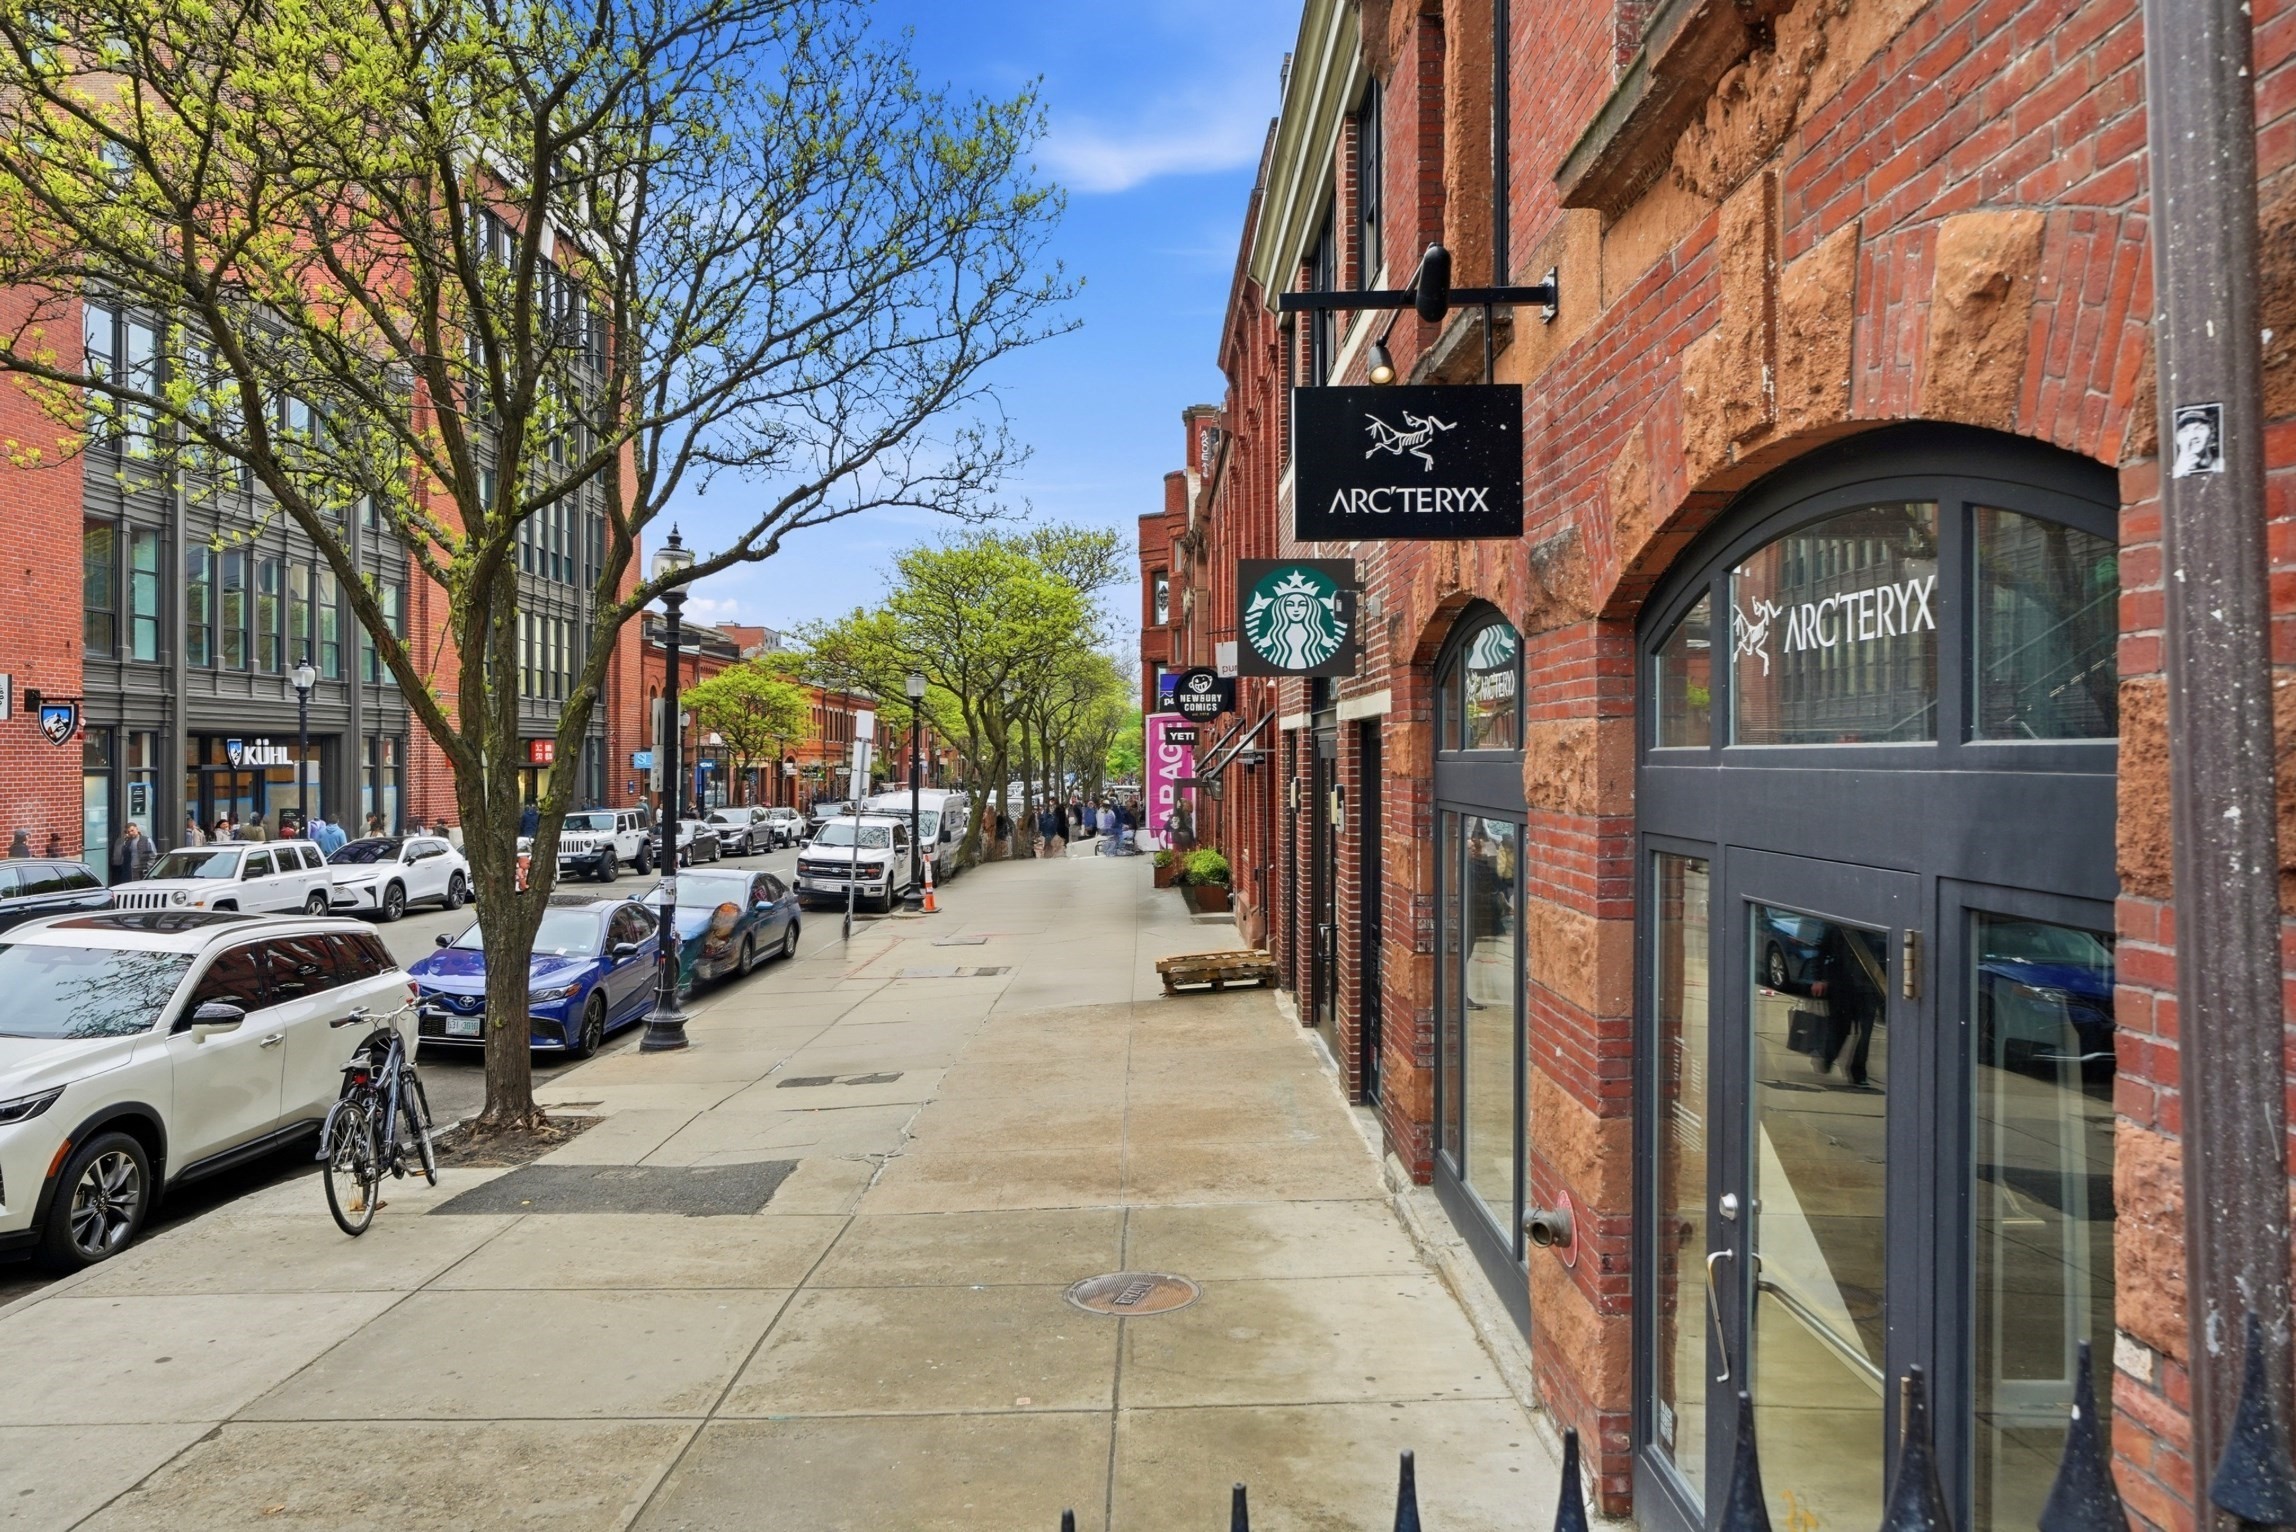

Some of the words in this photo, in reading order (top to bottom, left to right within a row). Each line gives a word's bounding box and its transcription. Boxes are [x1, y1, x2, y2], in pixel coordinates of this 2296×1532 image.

[1328, 486, 1490, 514] ARC'TERYX
[1783, 575, 1936, 654] ARC'TERYX
[1180, 694, 1222, 703] NEWBURY
[1184, 703, 1218, 712] COMICS
[1169, 732, 1195, 740] YETI
[242, 738, 295, 765] KÜHL
